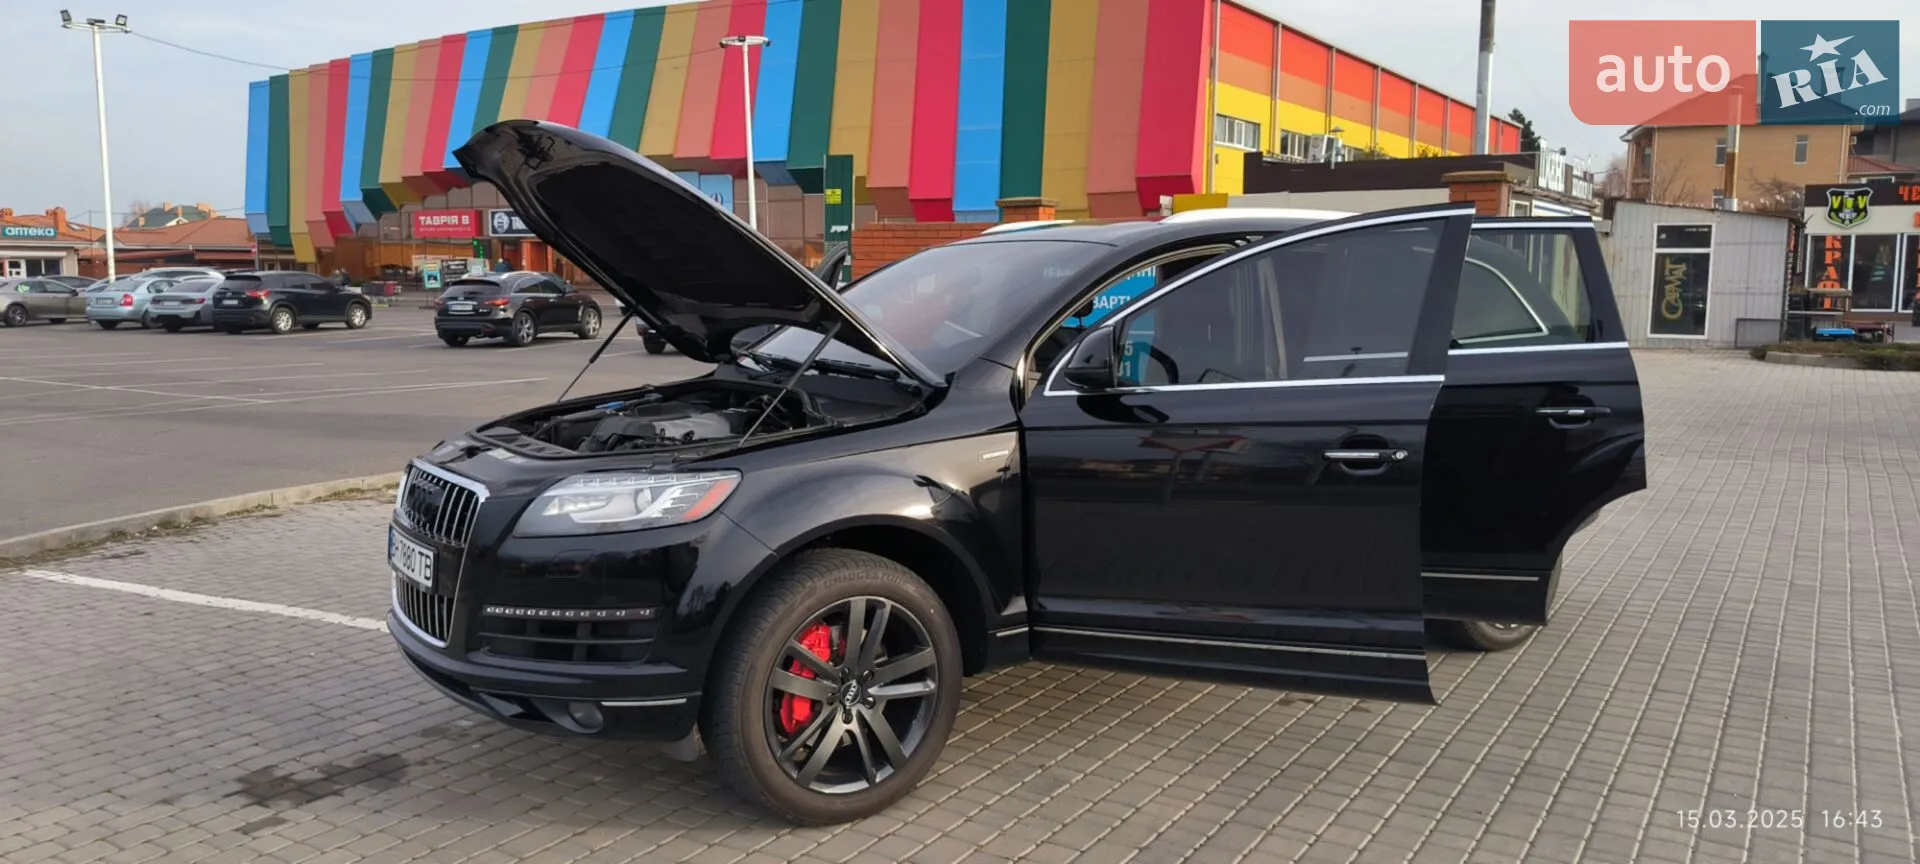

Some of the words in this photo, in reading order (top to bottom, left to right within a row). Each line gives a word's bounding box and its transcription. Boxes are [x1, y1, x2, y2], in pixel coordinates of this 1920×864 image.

[418, 215, 458, 225] ТАВРІЯ
[5, 227, 55, 236] аптека
[418, 550, 432, 582] TB
